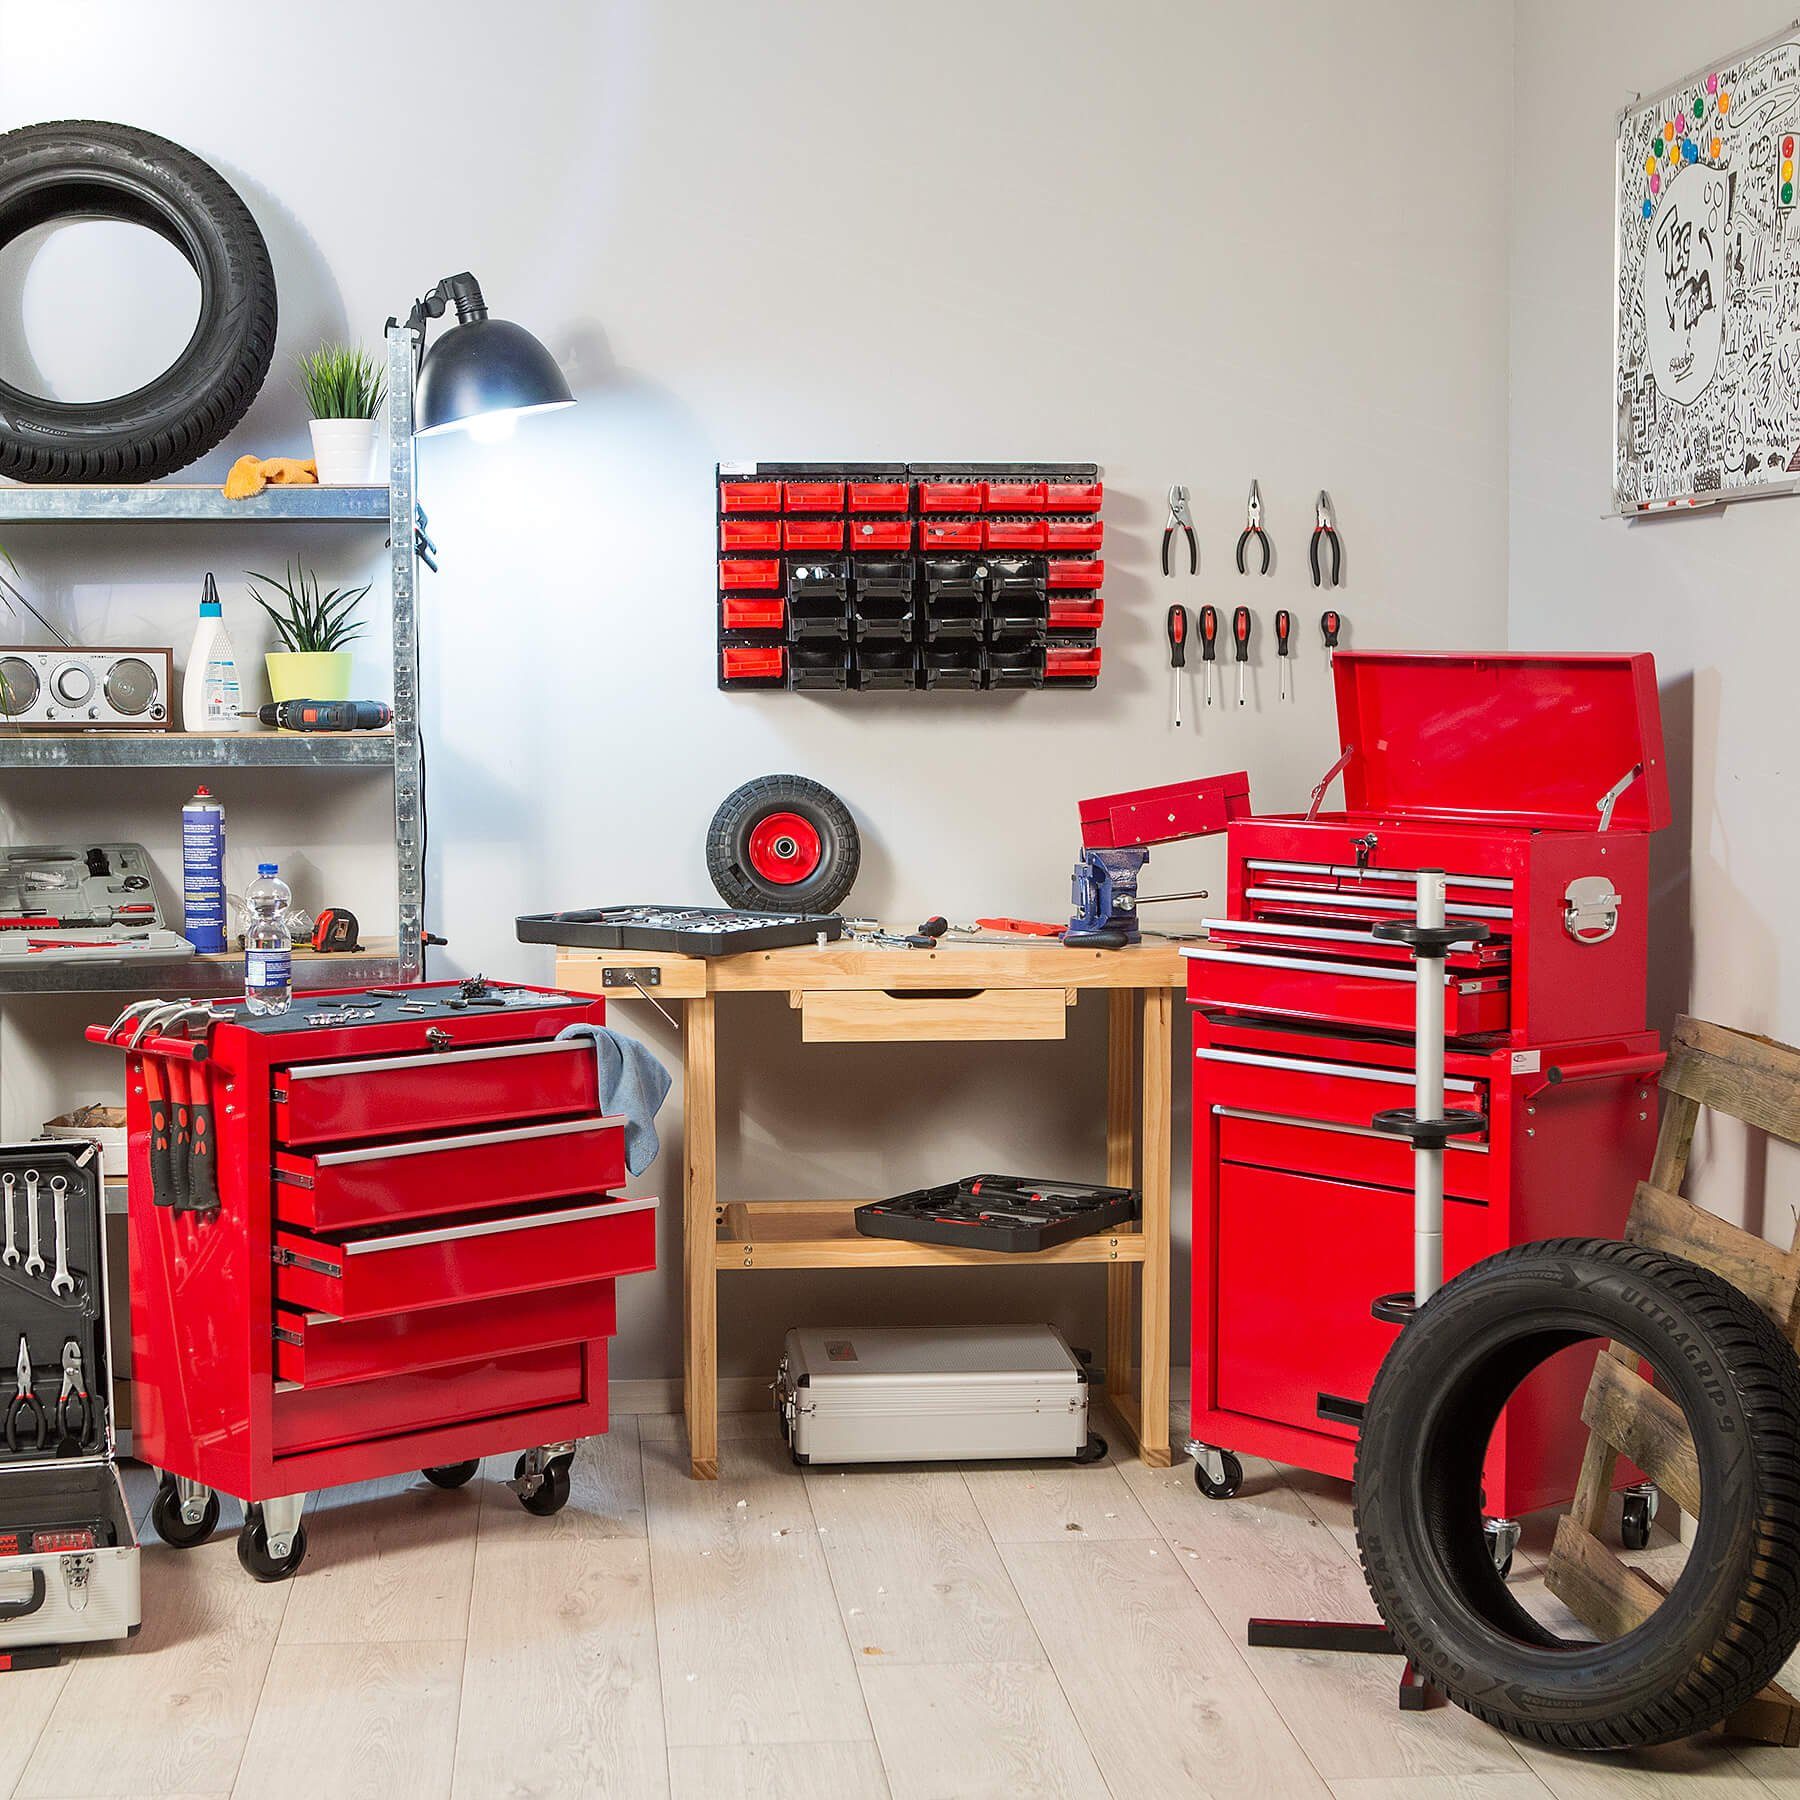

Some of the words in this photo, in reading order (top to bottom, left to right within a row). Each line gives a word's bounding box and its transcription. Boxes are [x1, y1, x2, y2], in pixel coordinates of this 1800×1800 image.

[1620, 1285, 1728, 1408] ULTRAGRIP
[1716, 1415, 1737, 1433] 9
[1367, 1534, 1467, 1682] GOODYEAR
